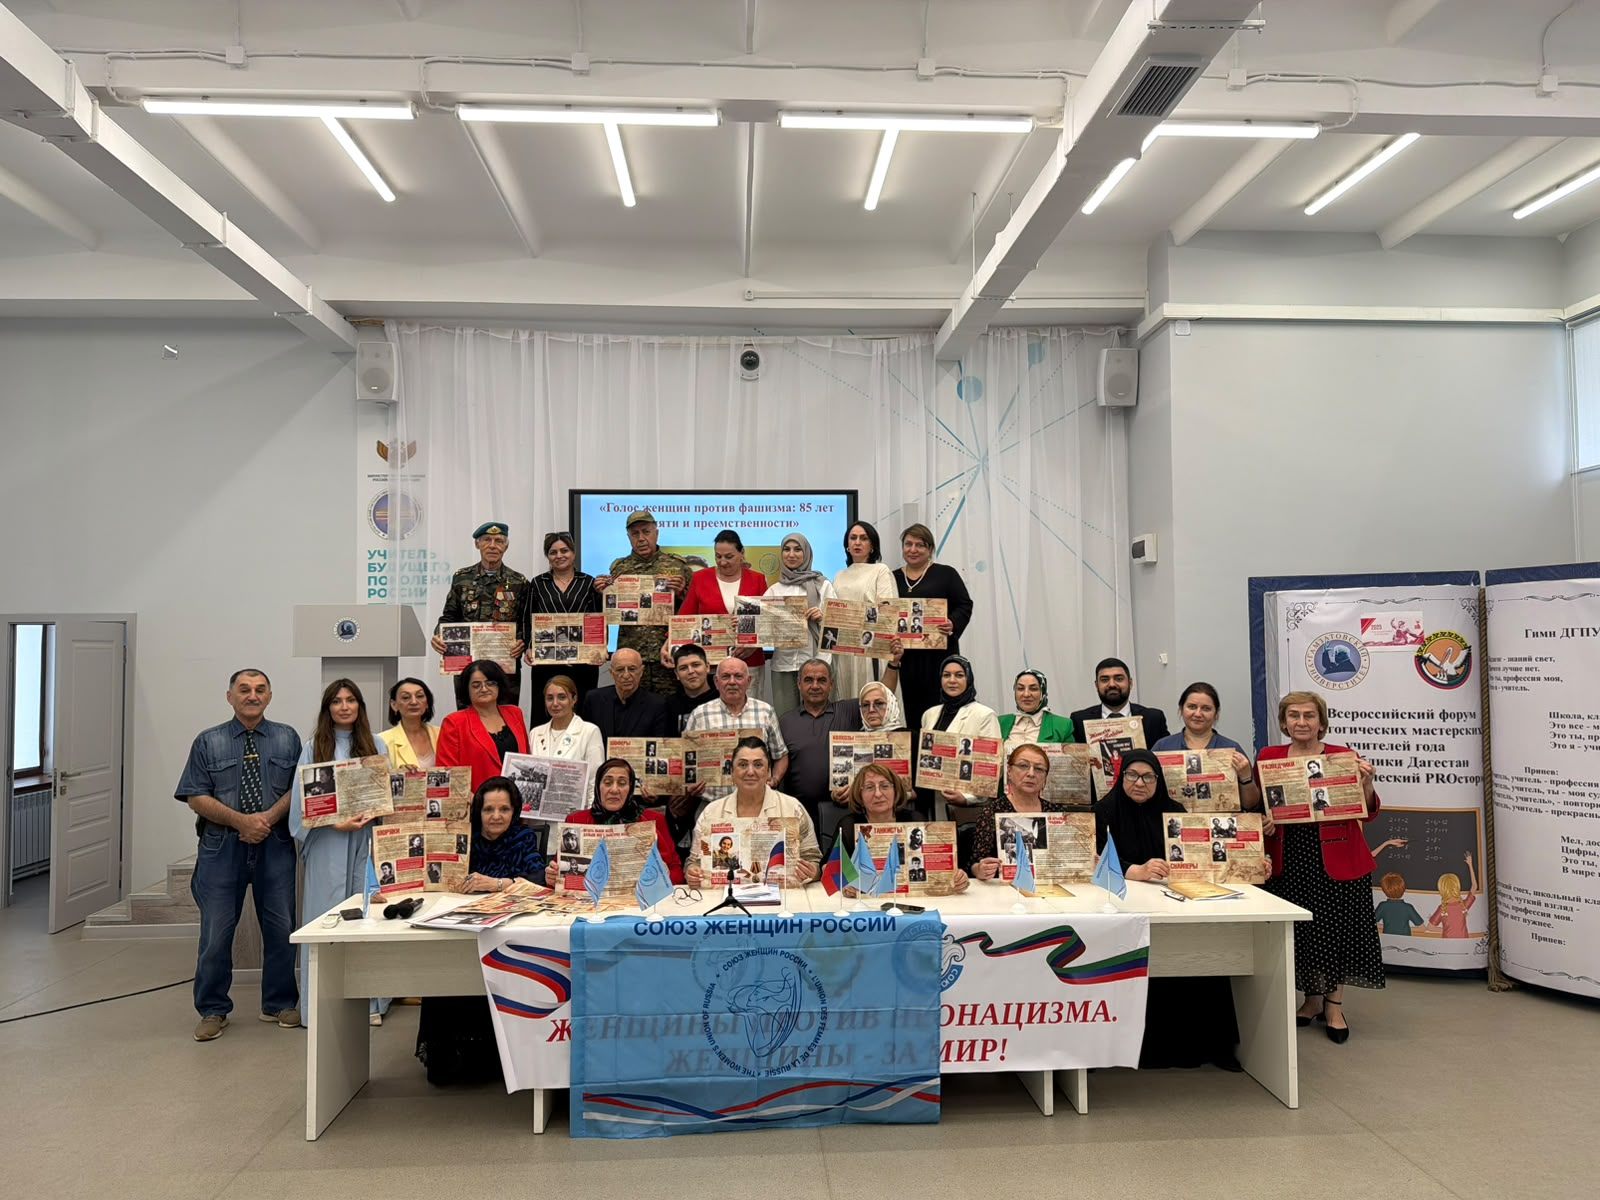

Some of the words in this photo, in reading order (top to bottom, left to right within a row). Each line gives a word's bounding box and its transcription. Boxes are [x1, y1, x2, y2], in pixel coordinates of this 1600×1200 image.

[600, 502, 639, 512] «Голос
[642, 503, 690, 514] женщин
[694, 504, 735, 515] против
[738, 502, 796, 514] фашизма:
[799, 502, 812, 512] 85
[815, 504, 833, 512] лет
[683, 519, 690, 527] и
[693, 519, 799, 530] преемственности»
[1525, 629, 1556, 639] Гимн
[1560, 627, 1600, 640] ДГПУ
[1503, 674, 1541, 684] профессия
[1328, 708, 1434, 722] Всероссийский
[1439, 709, 1476, 723] форум
[1549, 711, 1585, 721] Школа,
[1549, 721, 1566, 730] Это
[1328, 726, 1408, 736] гогических
[1412, 727, 1483, 739] мастерских
[1549, 731, 1567, 739] Это
[1570, 733, 1585, 741] ты,
[1345, 741, 1411, 753] учителей
[1416, 743, 1446, 752] года
[1550, 740, 1567, 750] Это
[1407, 757, 1469, 769] Дагестан
[1524, 766, 1559, 776] Припев:
[1511, 776, 1542, 784] учитель
[1549, 779, 1599, 788] профессия
[1511, 785, 1545, 795] учитель,
[1568, 790, 1586, 798] моя
[1512, 804, 1543, 813] учитель
[1561, 835, 1584, 846] Мел,
[1561, 846, 1599, 857] Цифры,
[1562, 856, 1579, 865] Это
[1581, 859, 1598, 868] ты,
[1571, 868, 1596, 878] мире
[1533, 890, 1582, 903] школьный
[1544, 901, 1574, 912] взгляд
[1522, 918, 1554, 929] нужнее.
[1554, 914, 1573, 922] моя.
[634, 920, 698, 936] СОЮЗ
[703, 918, 803, 938] ЖЕНЩИН
[809, 916, 897, 933] РОССИИ
[1531, 932, 1566, 946] Припев:
[722, 953, 744, 971] СОЮЗ
[744, 948, 778, 958] ЖЕНЩИН
[780, 949, 808, 969] РОССИИ
[703, 982, 716, 1009] RUSSIA
[812, 975, 826, 1005] L'UNION
[702, 1010, 710, 1020] OF
[820, 1007, 828, 1020] DES
[703, 1022, 716, 1045] UNION
[807, 1022, 827, 1053] FEMMES
[712, 1045, 741, 1073] WOMEN'S
[798, 1050, 810, 1063] DE
[791, 1058, 801, 1068] LA
[742, 1067, 757, 1077] THE
[765, 1064, 791, 1077] RUSSIE
